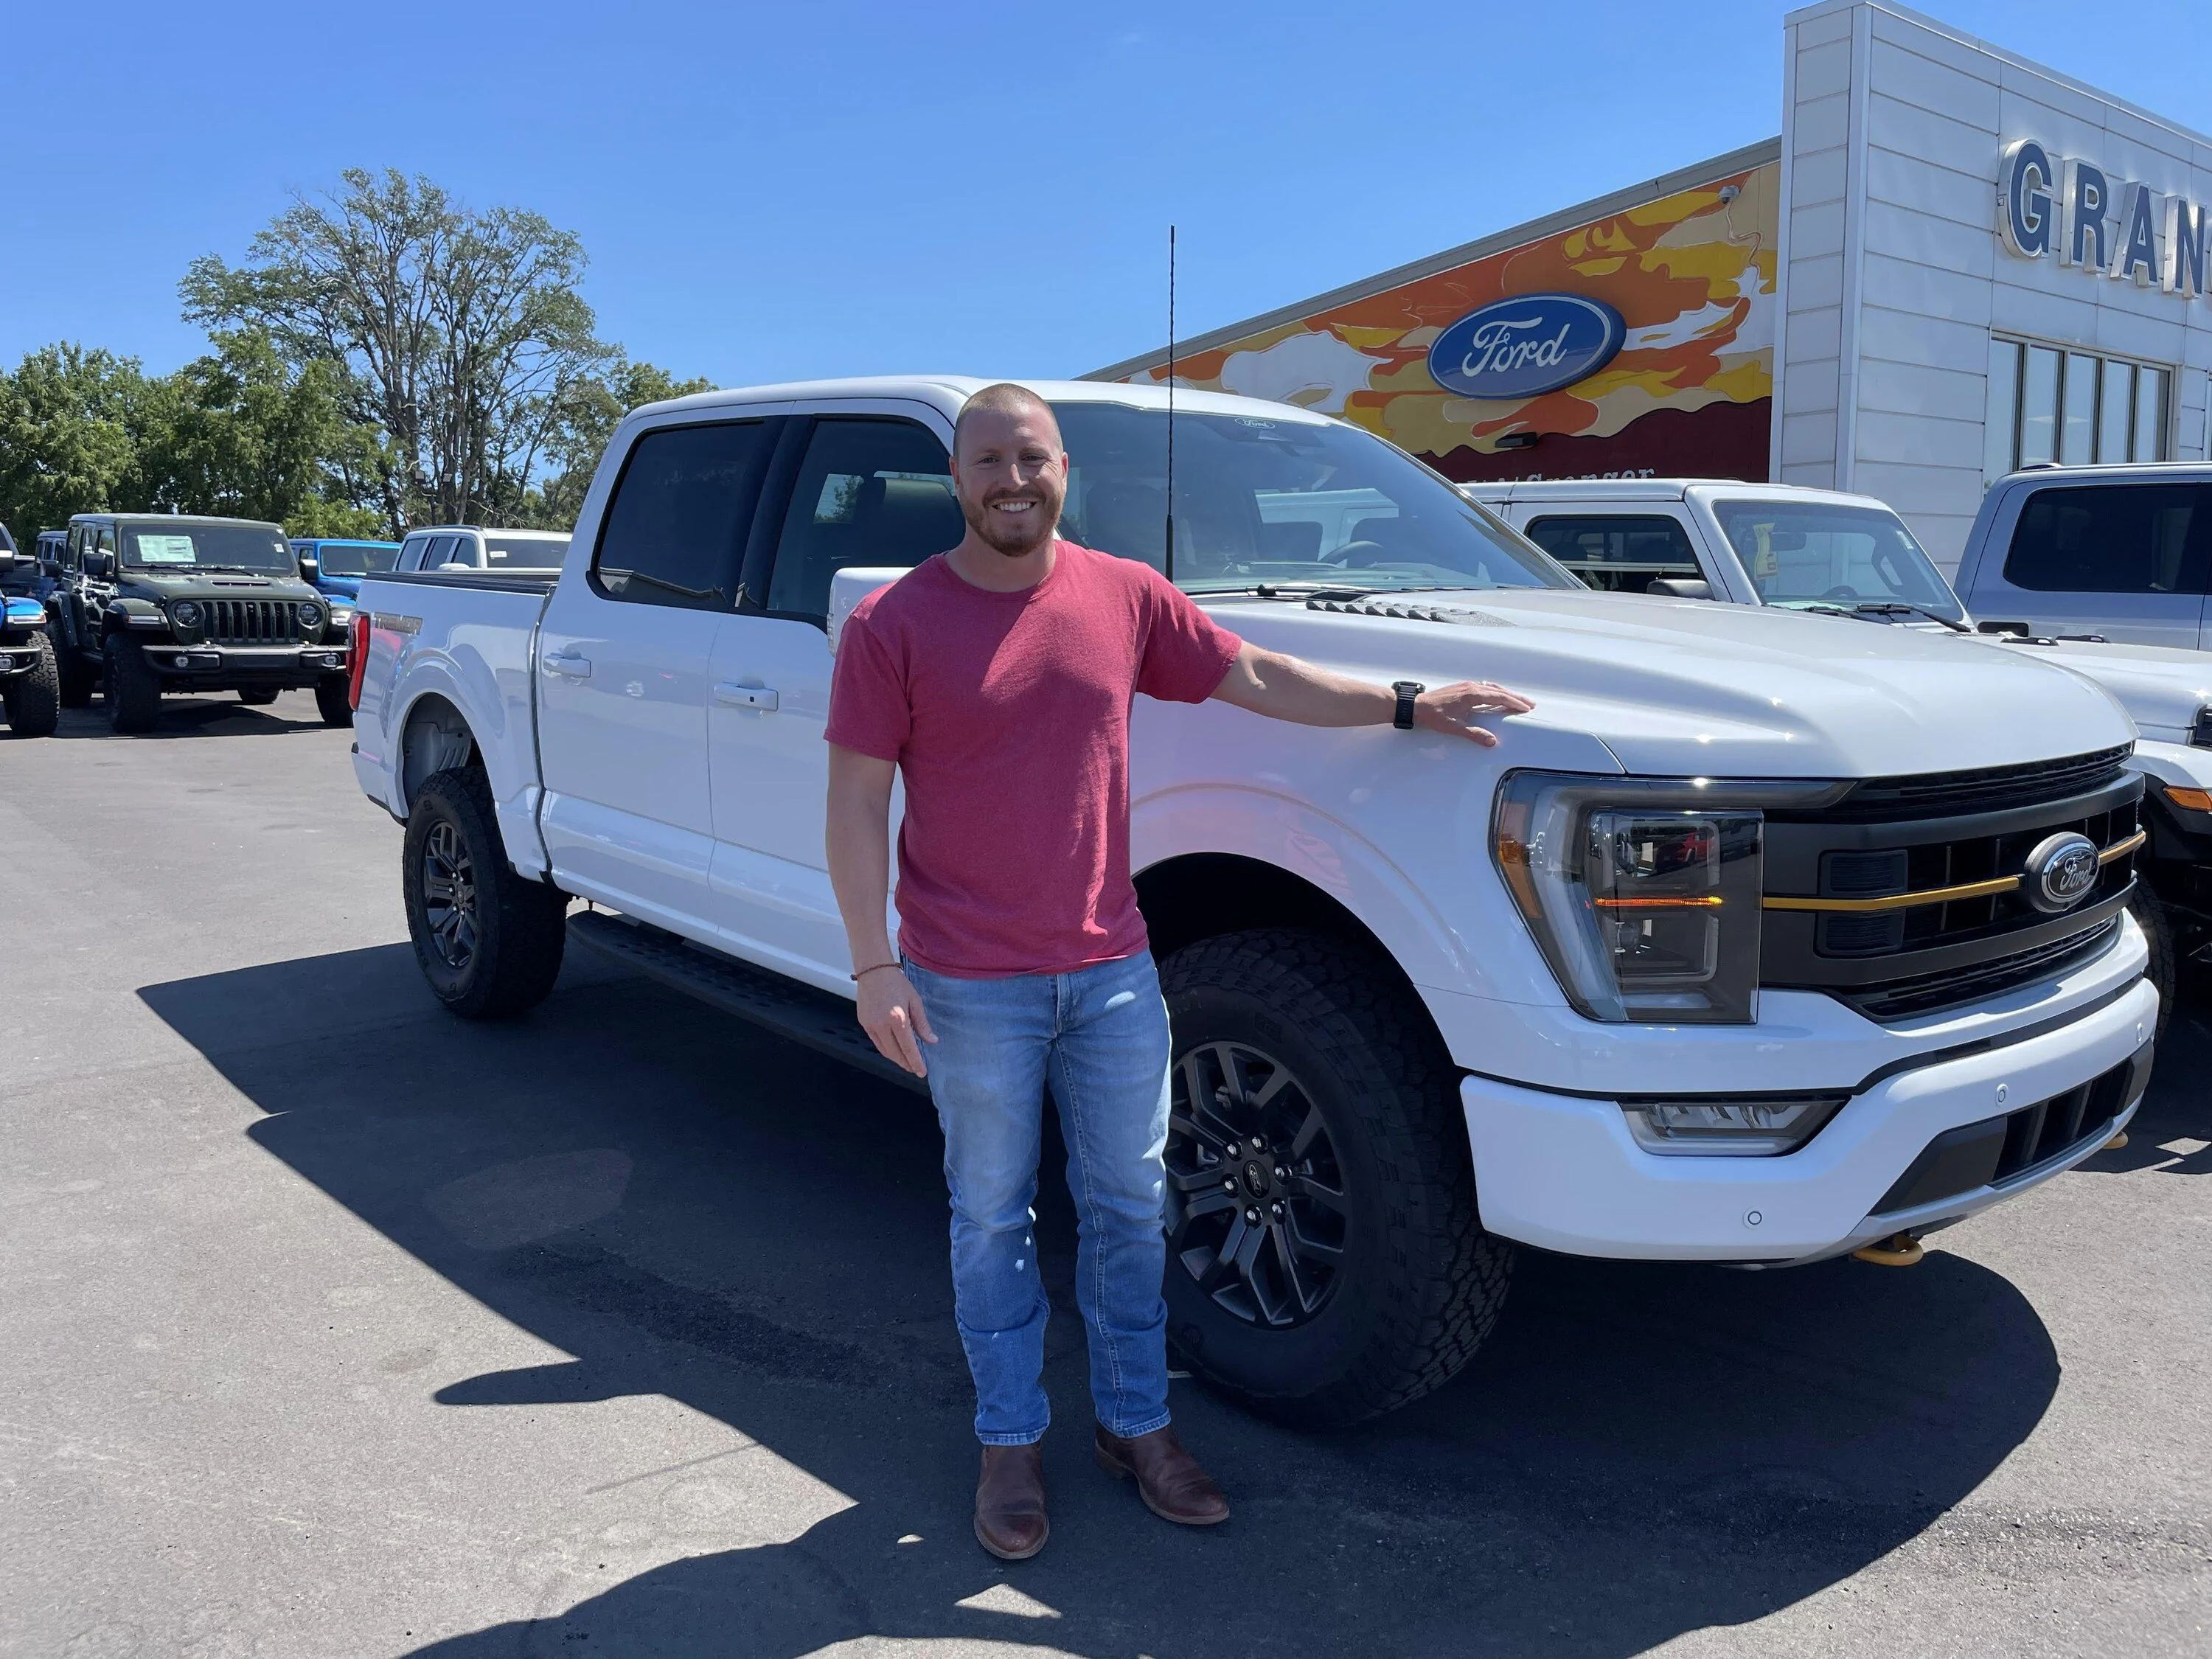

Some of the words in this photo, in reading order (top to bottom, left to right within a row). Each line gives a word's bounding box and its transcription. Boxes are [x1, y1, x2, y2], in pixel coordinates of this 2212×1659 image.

[1998, 139, 2212, 299] GRAN
[1462, 316, 1571, 378] Ford
[2059, 855, 2093, 891] Ford
